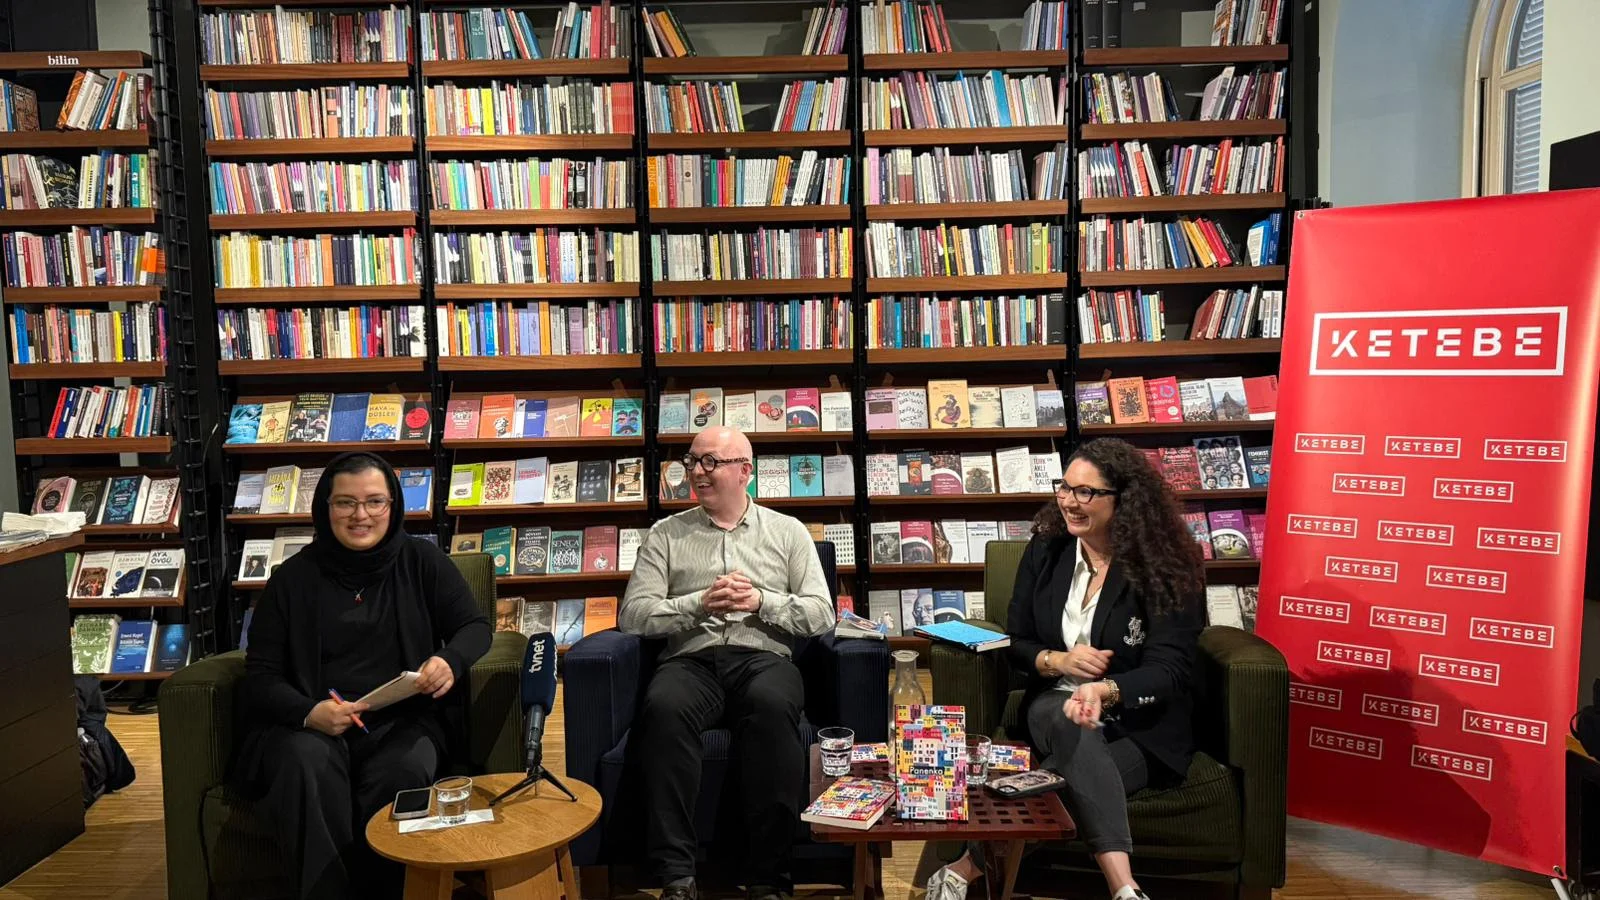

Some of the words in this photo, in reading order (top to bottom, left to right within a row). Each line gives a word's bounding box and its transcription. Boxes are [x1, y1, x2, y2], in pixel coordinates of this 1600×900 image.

[47, 55, 79, 66] bilim
[1332, 327, 1542, 358] KETEBE
[1302, 439, 1358, 449] KETEBE
[1392, 442, 1454, 452] KETEBE
[1492, 445, 1560, 456] KETEBE
[1340, 479, 1398, 490] KETEBE
[1441, 484, 1506, 496] KETEBE
[1294, 520, 1351, 532] KETEBE
[1384, 526, 1446, 540] KETEBE
[1485, 534, 1553, 548] KETEBE
[1332, 562, 1391, 576] KETEBE
[1434, 572, 1499, 586] KETEBE
[1286, 602, 1343, 617] KETEBE
[1377, 613, 1439, 628] KETEBE
[1478, 624, 1546, 641] KETEBE
[528, 639, 546, 674] tvnet
[1324, 647, 1384, 663] KETEBE
[1426, 661, 1492, 678] KETEBE
[1289, 688, 1335, 703] ETEBE
[1370, 701, 1432, 719] KETEBE
[1470, 717, 1539, 736] KETEBE
[1316, 734, 1376, 752] KETEBE
[1419, 753, 1484, 773] KETEBE
[910, 767, 944, 775] Panenka
